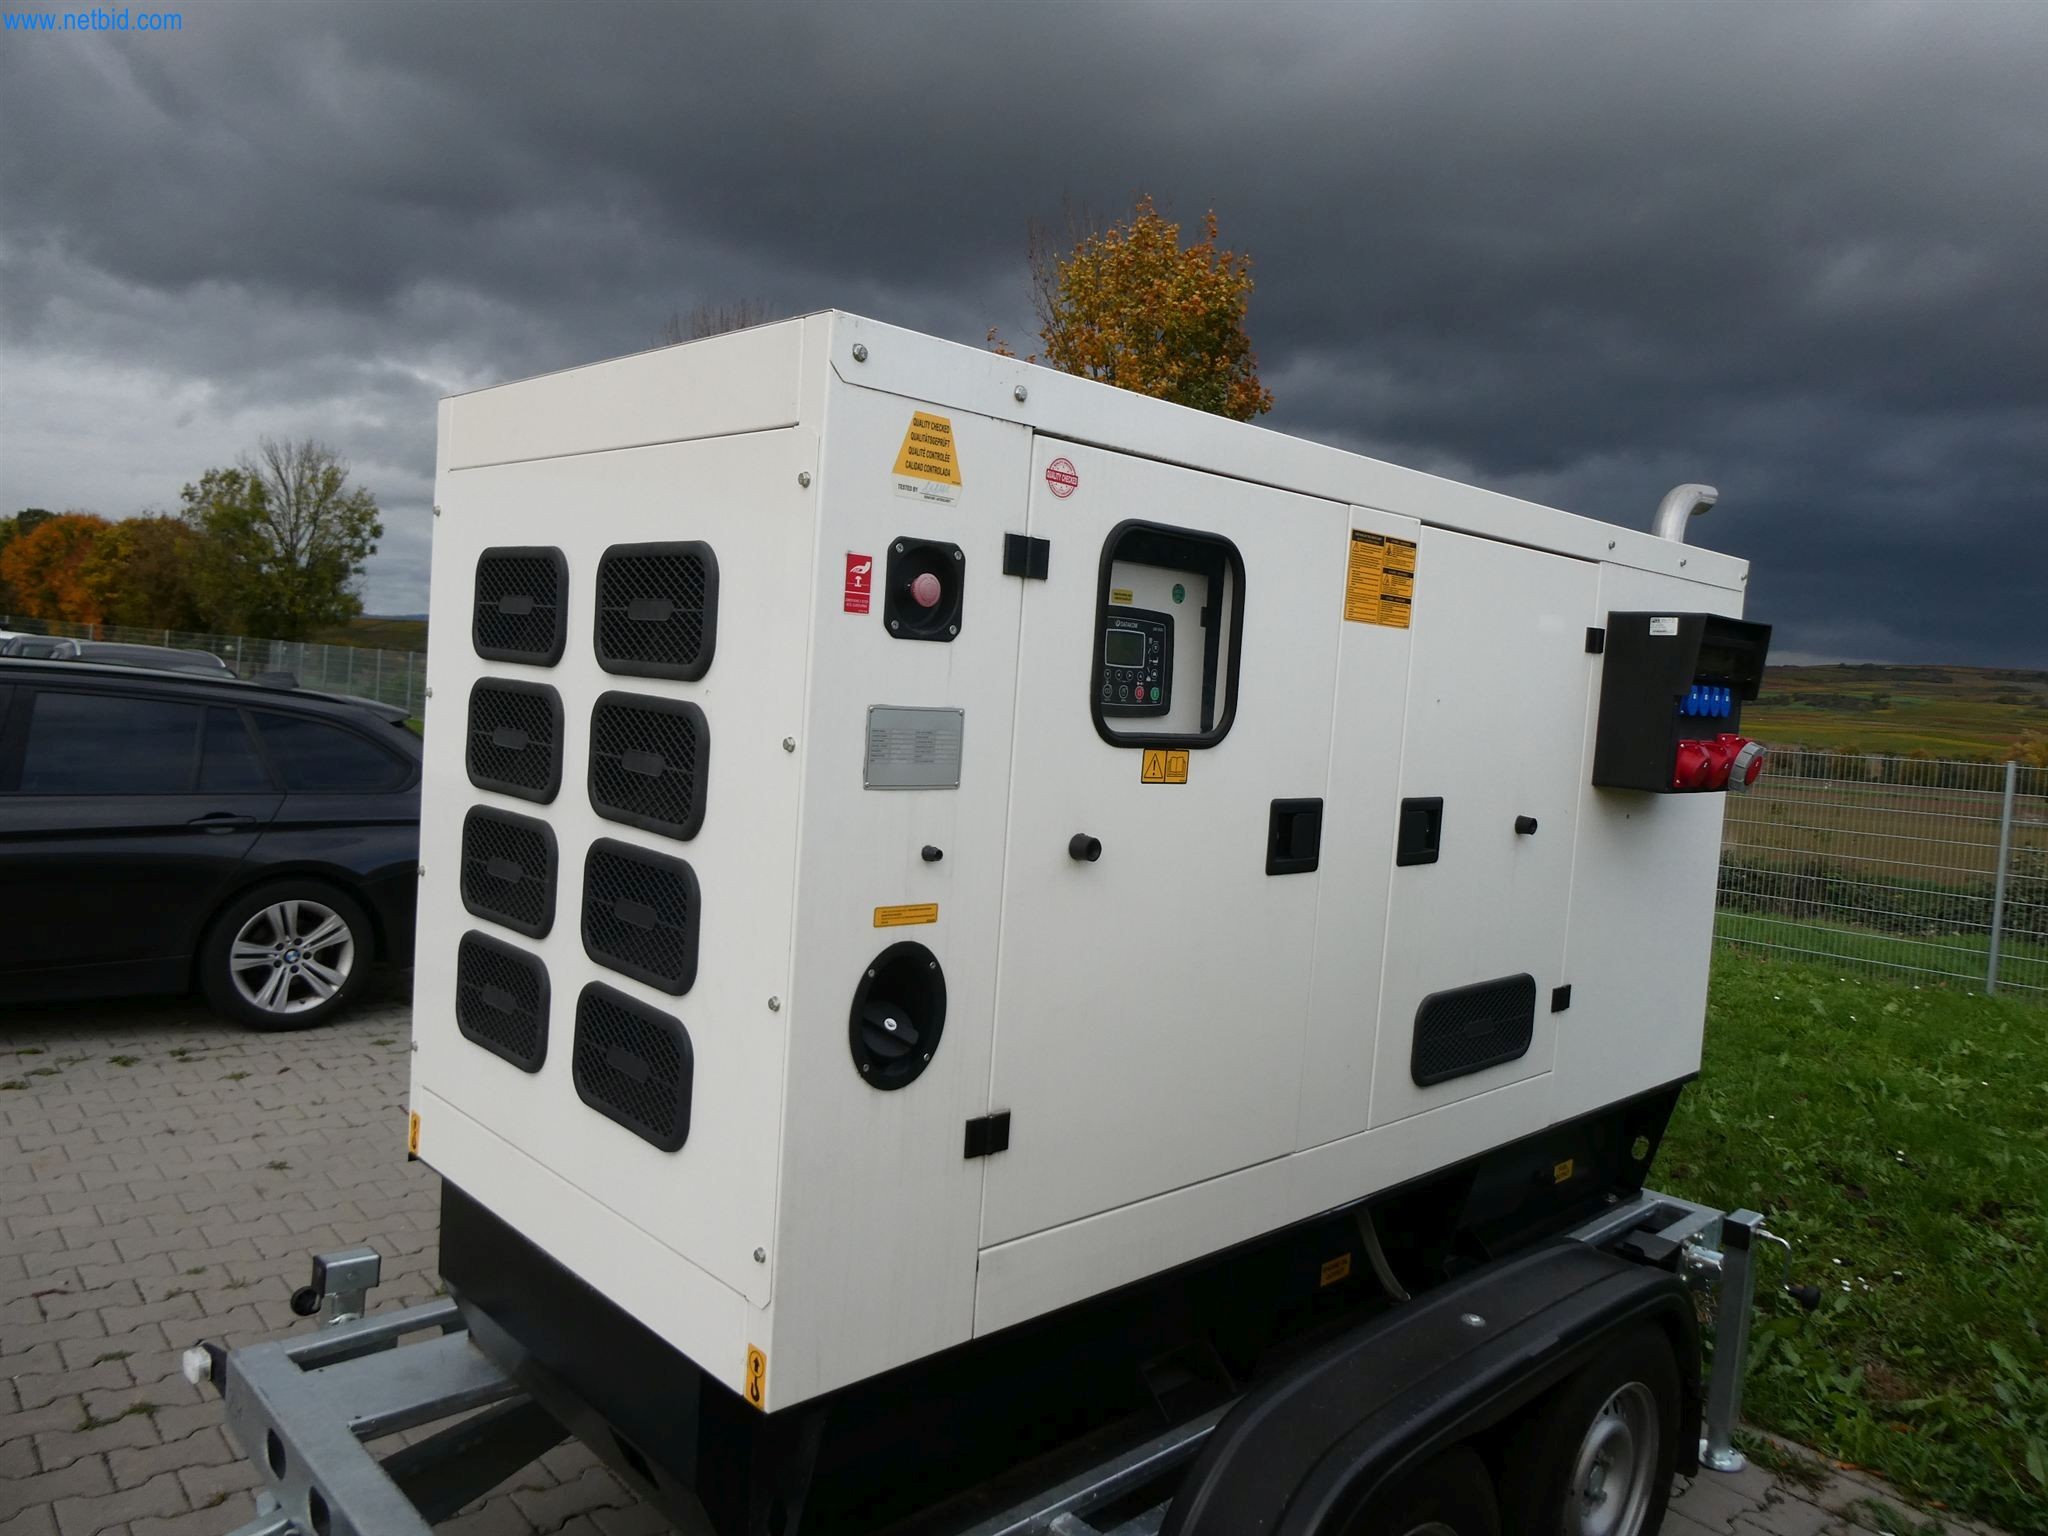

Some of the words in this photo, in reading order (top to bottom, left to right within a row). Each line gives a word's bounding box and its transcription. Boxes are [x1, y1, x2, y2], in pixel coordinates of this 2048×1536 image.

[913, 417, 930, 429] QUALITY
[931, 422, 950, 433] CHECKED
[905, 460, 923, 471] CALIDAD
[924, 463, 950, 476] CONTROLADA
[898, 483, 912, 492] TESTED
